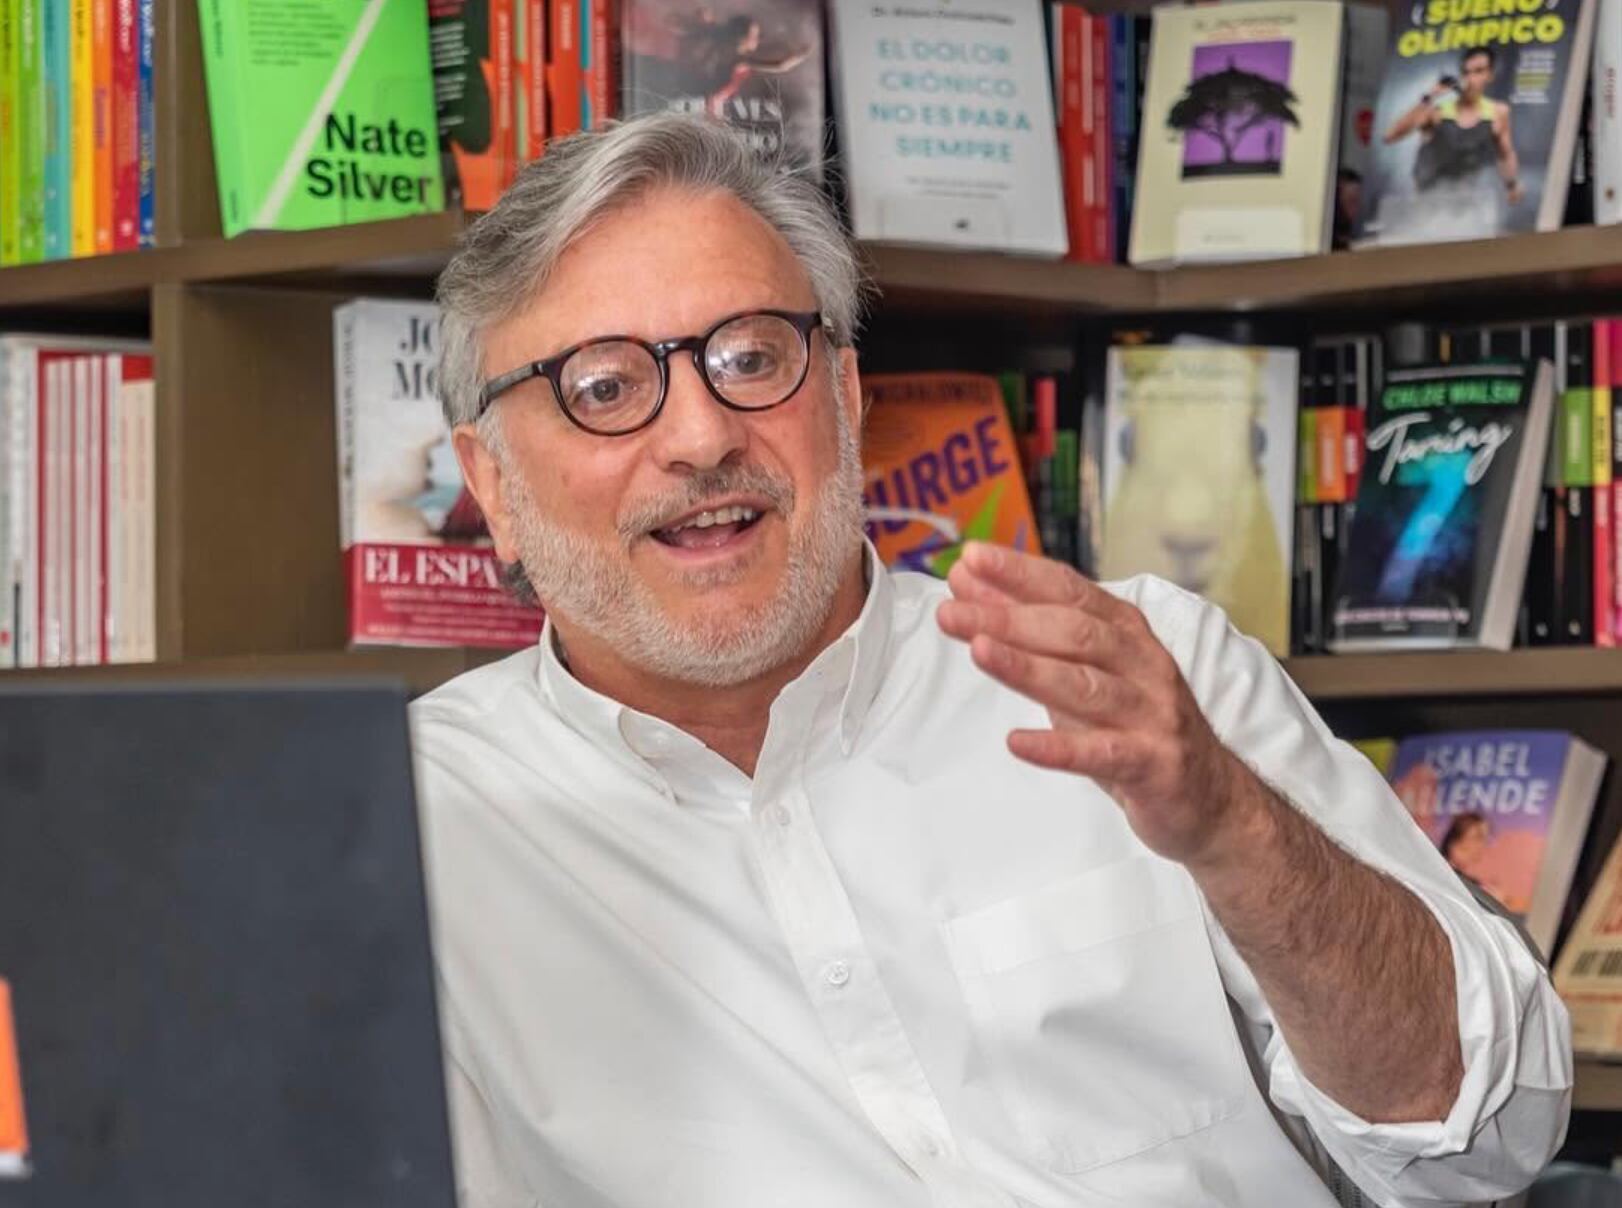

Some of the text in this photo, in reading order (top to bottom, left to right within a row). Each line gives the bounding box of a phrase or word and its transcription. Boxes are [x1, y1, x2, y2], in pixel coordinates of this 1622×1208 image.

[877, 38, 1011, 64] EL DOLOR
[1397, 13, 1565, 58] OLÍMPICO
[880, 68, 1017, 98] CRÓNICO
[869, 103, 915, 124] NO
[957, 106, 1031, 131] PARA
[325, 112, 428, 159] Nate
[896, 136, 1014, 163] SIEMPRE
[306, 158, 433, 204] Silver
[364, 548, 504, 590] EL ESPA
[1424, 742, 1531, 778] ISABEL
